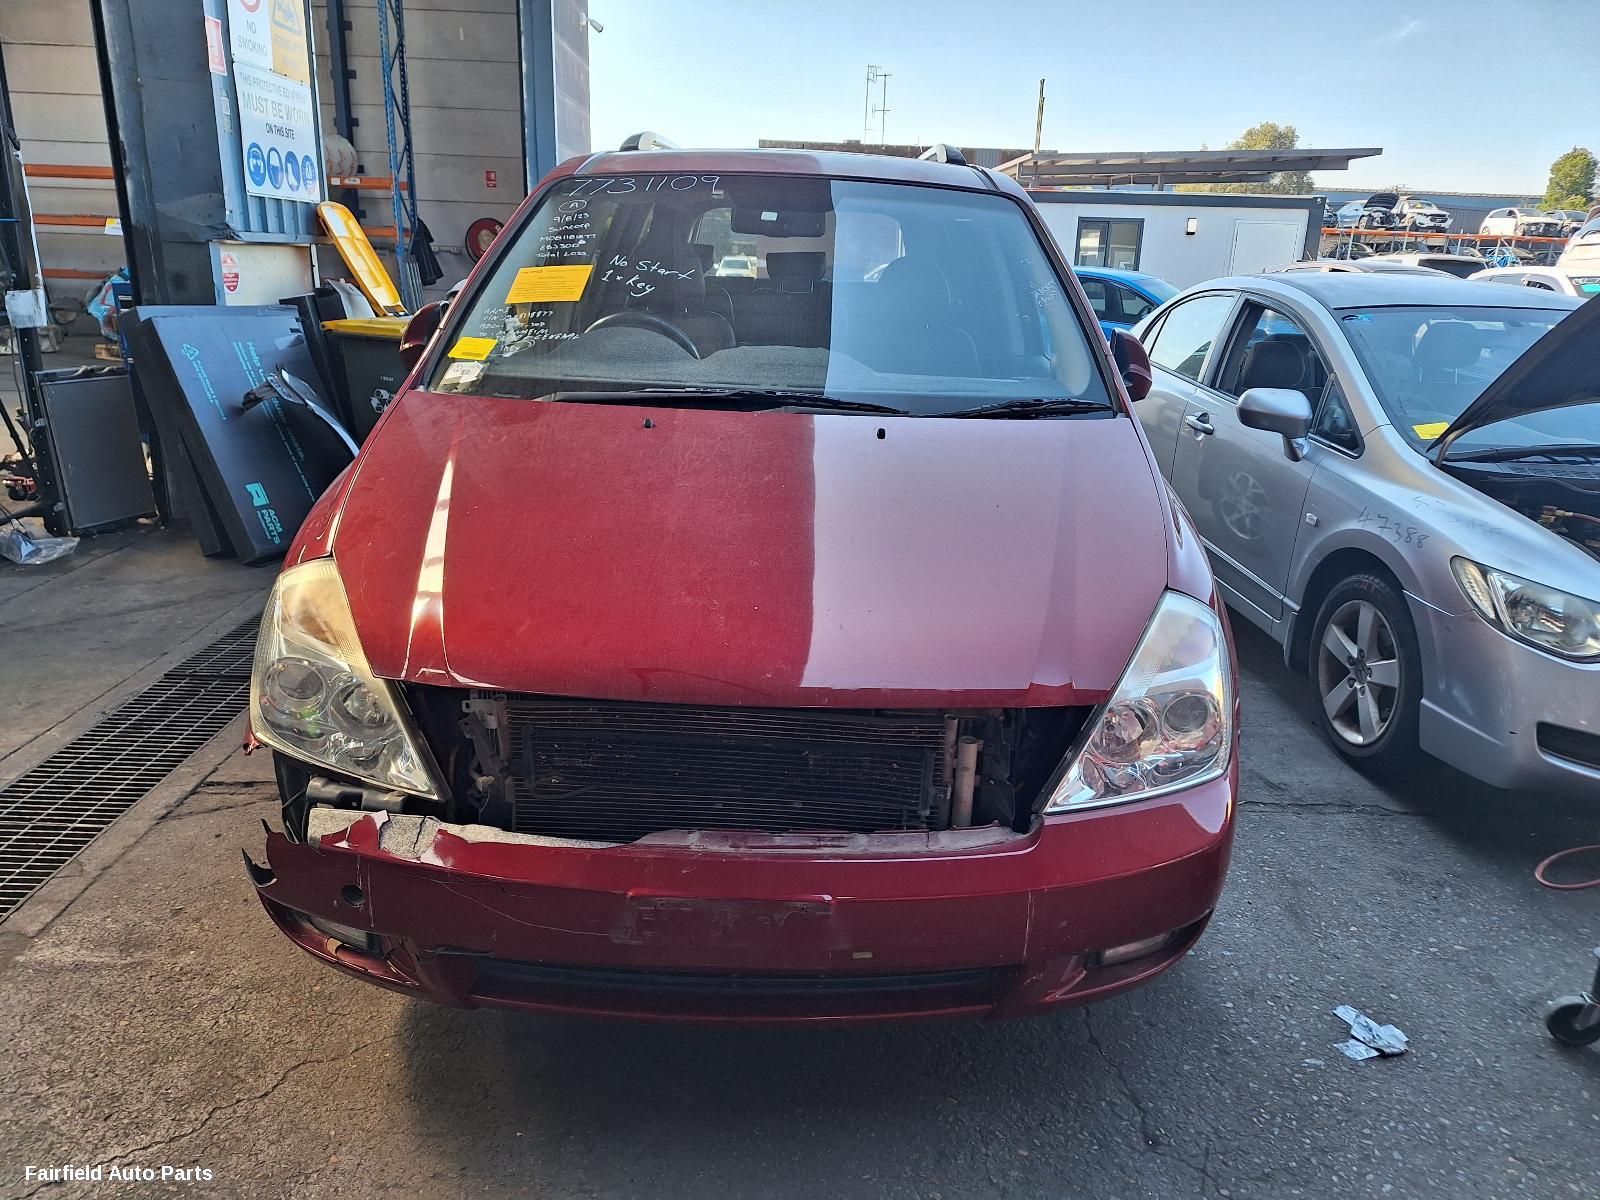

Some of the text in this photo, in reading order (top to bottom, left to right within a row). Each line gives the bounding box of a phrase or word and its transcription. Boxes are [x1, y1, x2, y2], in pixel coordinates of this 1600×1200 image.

[246, 20, 257, 34] NO
[237, 35, 268, 57] SMOKING
[239, 72, 252, 87] THIS
[253, 75, 282, 97] PROTECTIVE
[242, 91, 311, 127] MUST BE WORN
[265, 122, 295, 140] ON THIS SITE
[568, 176, 720, 197] 7731109
[553, 212, 590, 224] 9/8/23
[601, 269, 614, 282] 1
[609, 254, 696, 281] No Start
[246, 341, 261, 368] Help
[260, 508, 281, 545] PARTS
[267, 508, 284, 533] ACM
[1357, 506, 1430, 549] 47388
